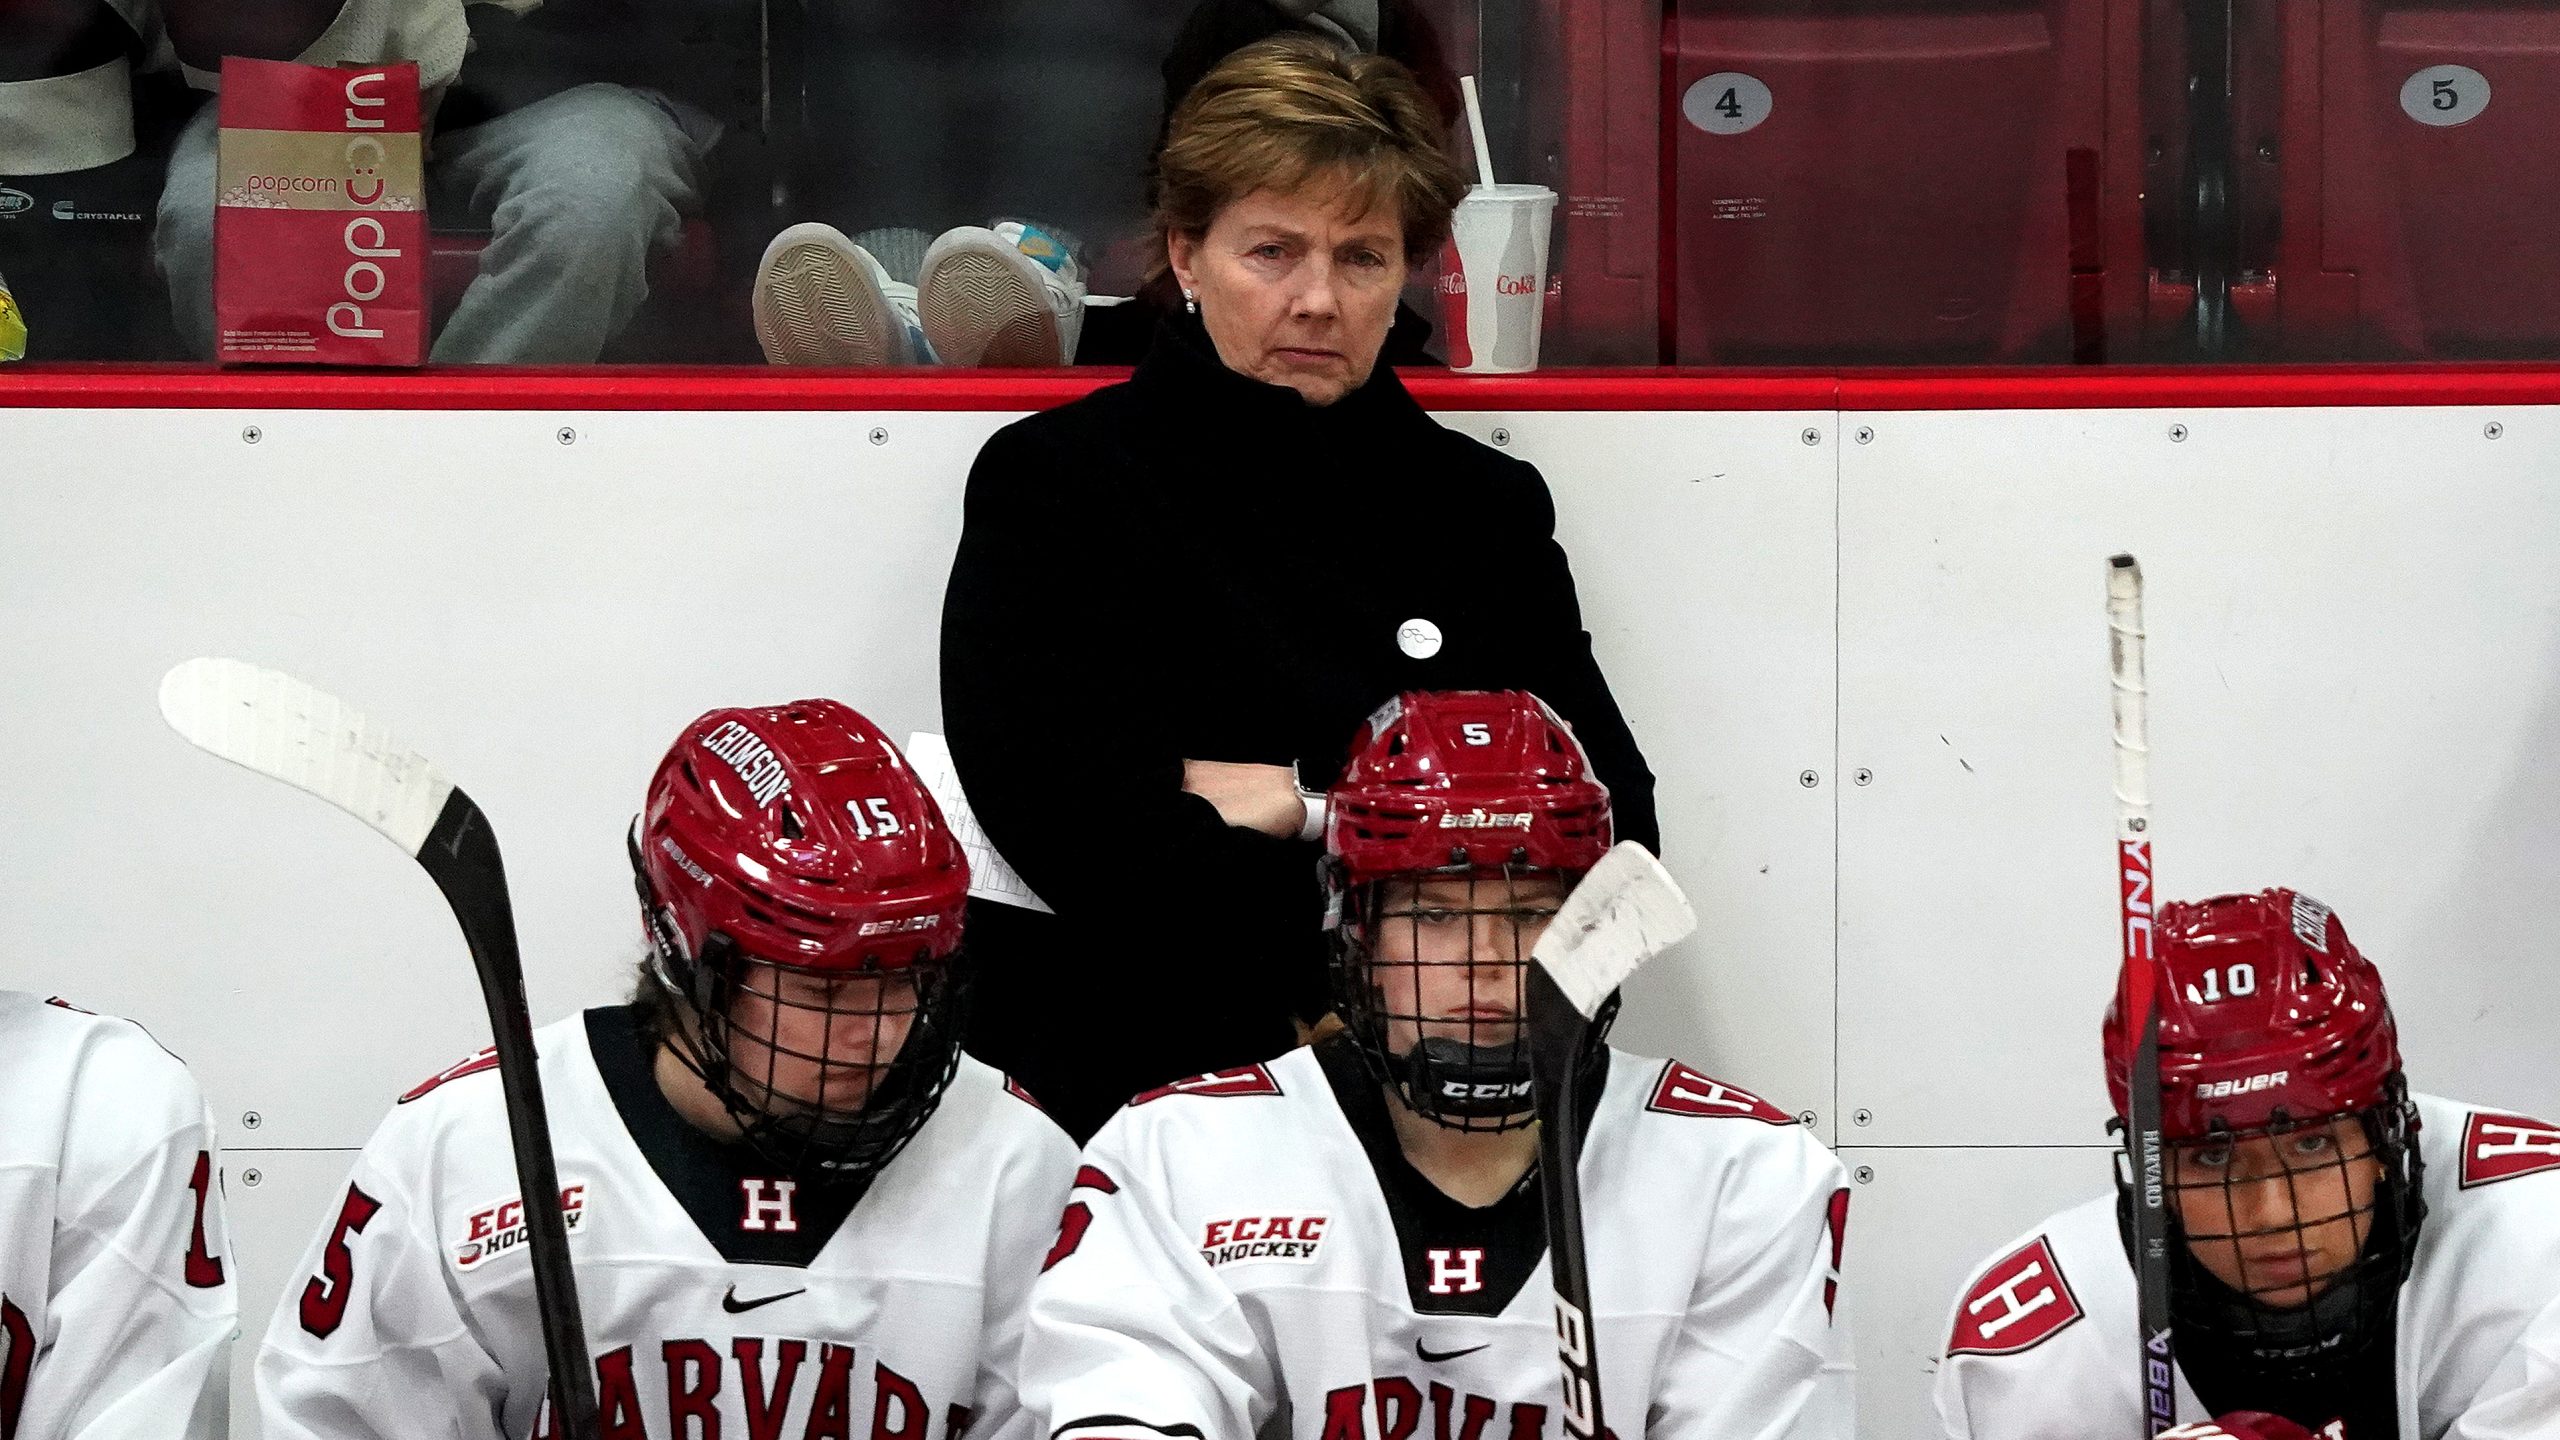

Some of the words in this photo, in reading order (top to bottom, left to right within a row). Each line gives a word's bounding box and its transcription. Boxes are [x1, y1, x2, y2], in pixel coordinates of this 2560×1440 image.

[1714, 87, 1742, 118] 4
[2432, 79, 2458, 110] 5
[248, 175, 337, 194] popcorn
[326, 72, 401, 338] popcorn
[1496, 275, 1536, 295] Coke
[1462, 723, 1492, 746] 5
[701, 720, 796, 809] CRIMSON
[846, 797, 904, 840] 15
[2124, 840, 2154, 960] YNC
[2202, 962, 2256, 1001] 10
[1441, 1080, 1533, 1099] CCM
[1670, 1070, 1760, 1112] H
[2477, 1123, 2560, 1160] H
[2142, 1130, 2163, 1208] HARVARD
[467, 1185, 585, 1242] ECC
[741, 1177, 798, 1232] H
[484, 1211, 581, 1256] HOCY
[1203, 1216, 1327, 1249] ECAC
[1216, 1241, 1317, 1264] HOCKEY
[299, 1179, 383, 1342] 5
[1427, 1248, 1486, 1294] H
[1968, 1260, 2057, 1340] H
